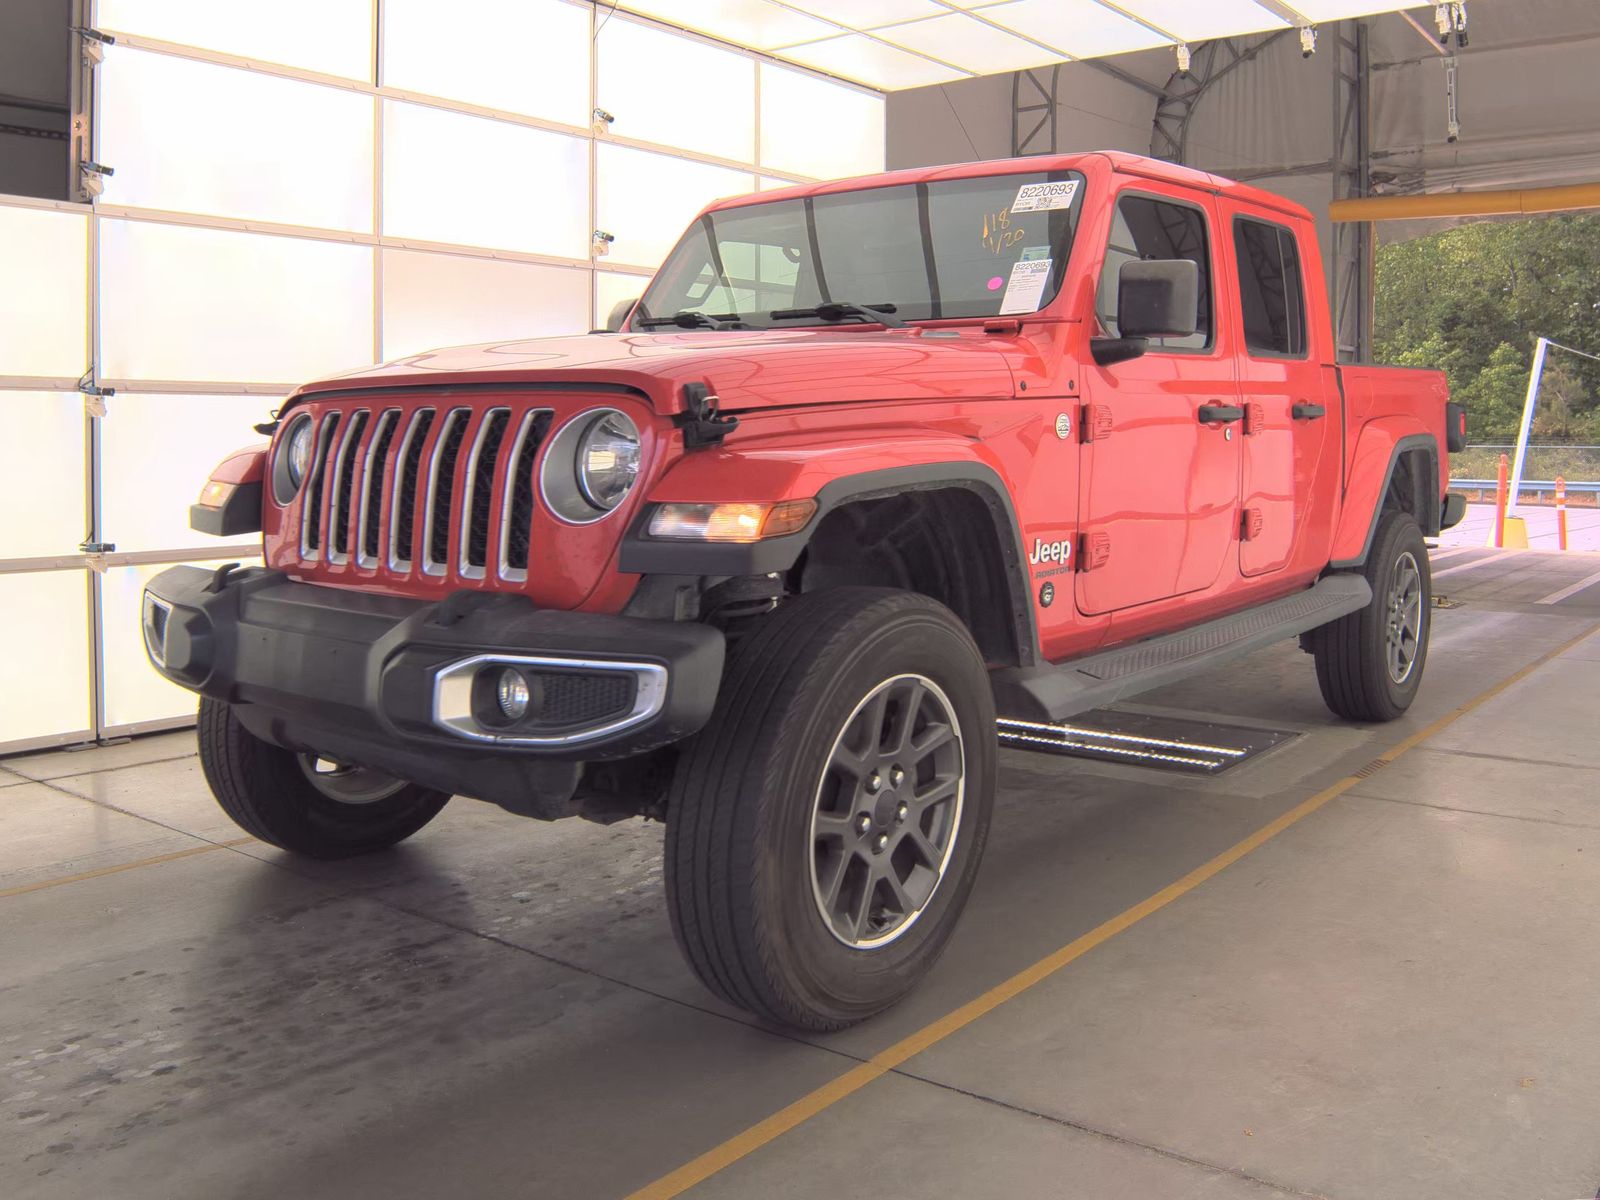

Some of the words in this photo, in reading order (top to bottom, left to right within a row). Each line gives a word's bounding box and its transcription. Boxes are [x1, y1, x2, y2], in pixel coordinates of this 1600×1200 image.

[1020, 183, 1074, 199] 8220693
[1014, 261, 1051, 271] 8220693
[1029, 538, 1071, 565] Jeep
